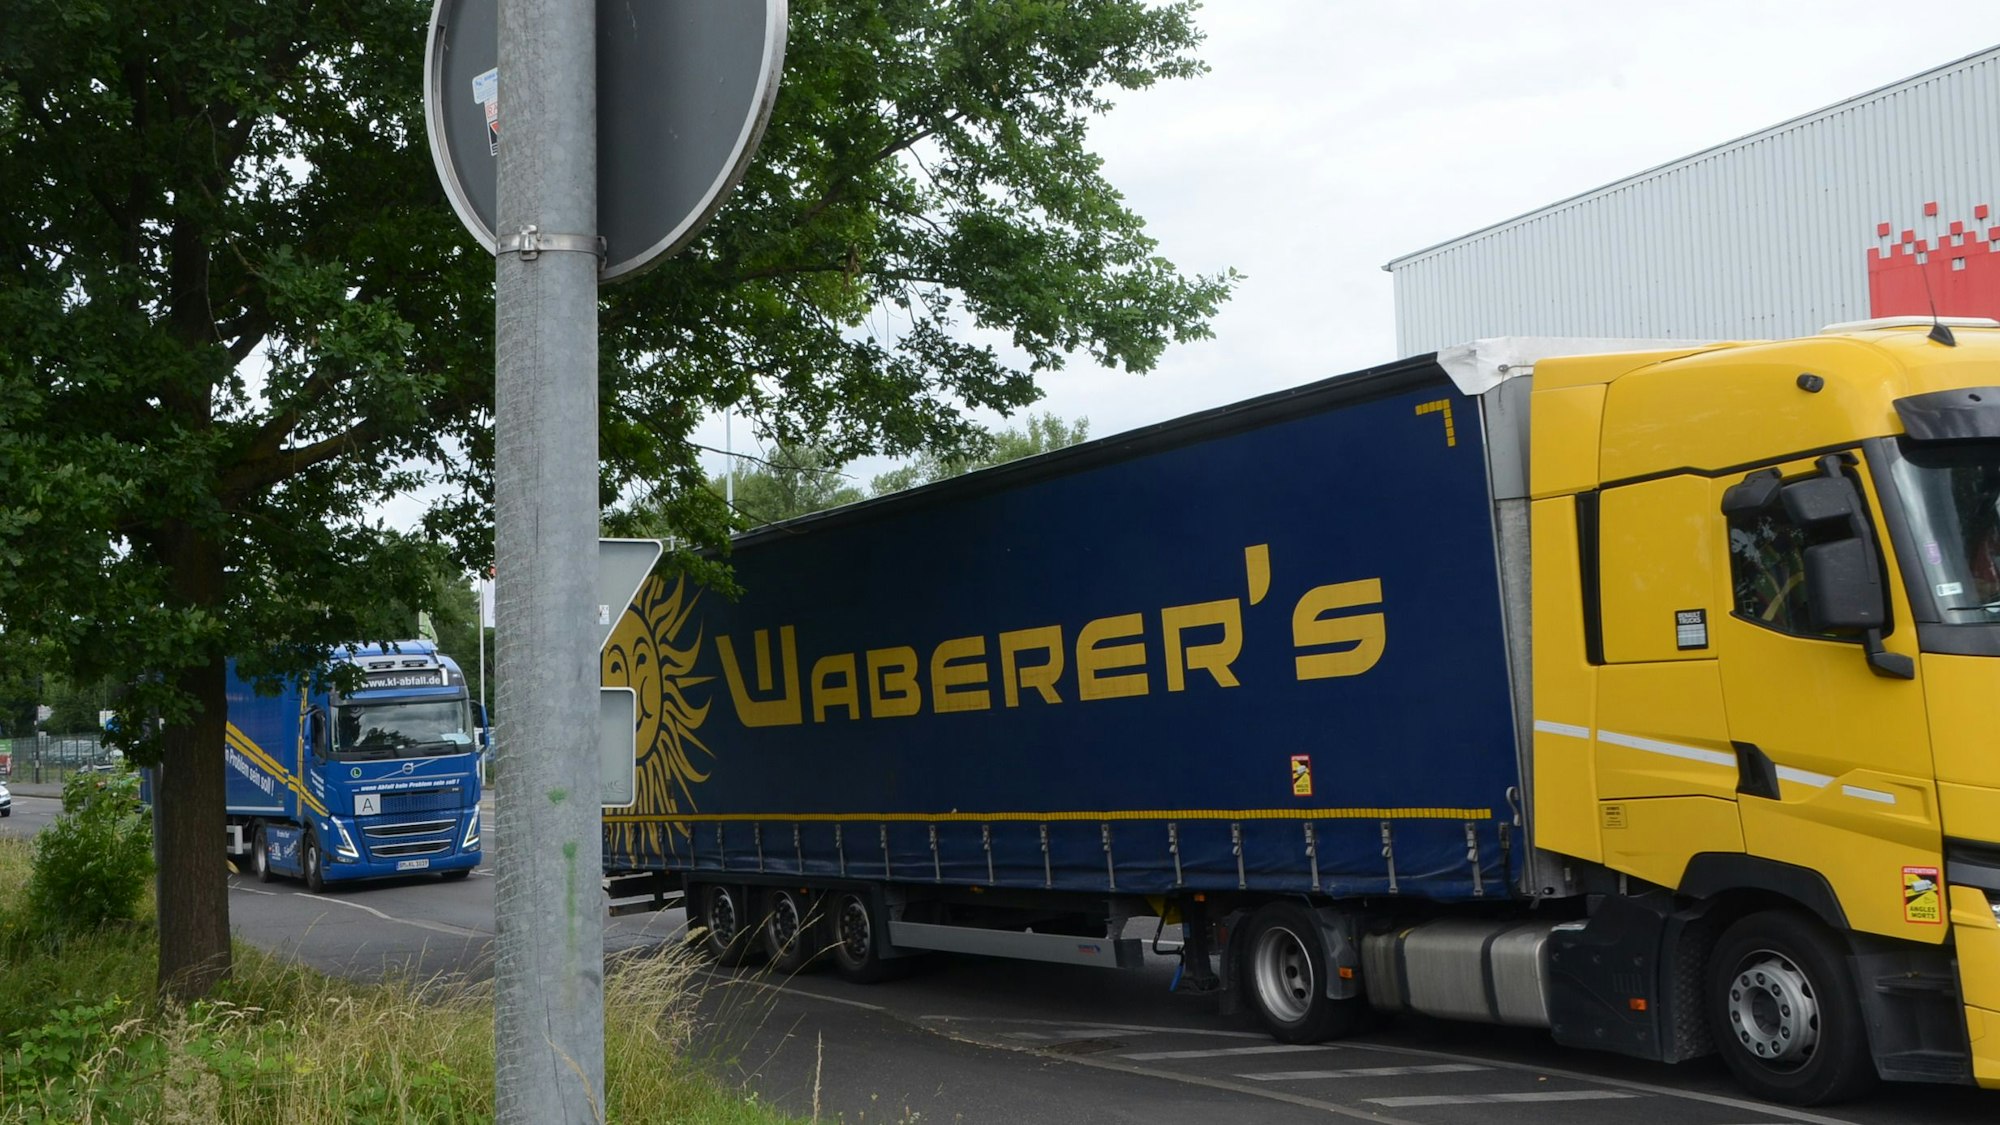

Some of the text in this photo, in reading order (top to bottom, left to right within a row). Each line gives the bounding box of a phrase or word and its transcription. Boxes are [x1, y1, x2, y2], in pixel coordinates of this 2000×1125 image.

[1678, 617, 1702, 625] TRUCKS
[715, 543, 1386, 727] WABERER'S
[362, 798, 374, 812] A
[1903, 867, 1937, 875] ATTENTION
[1910, 905, 1936, 913] ANGLES
